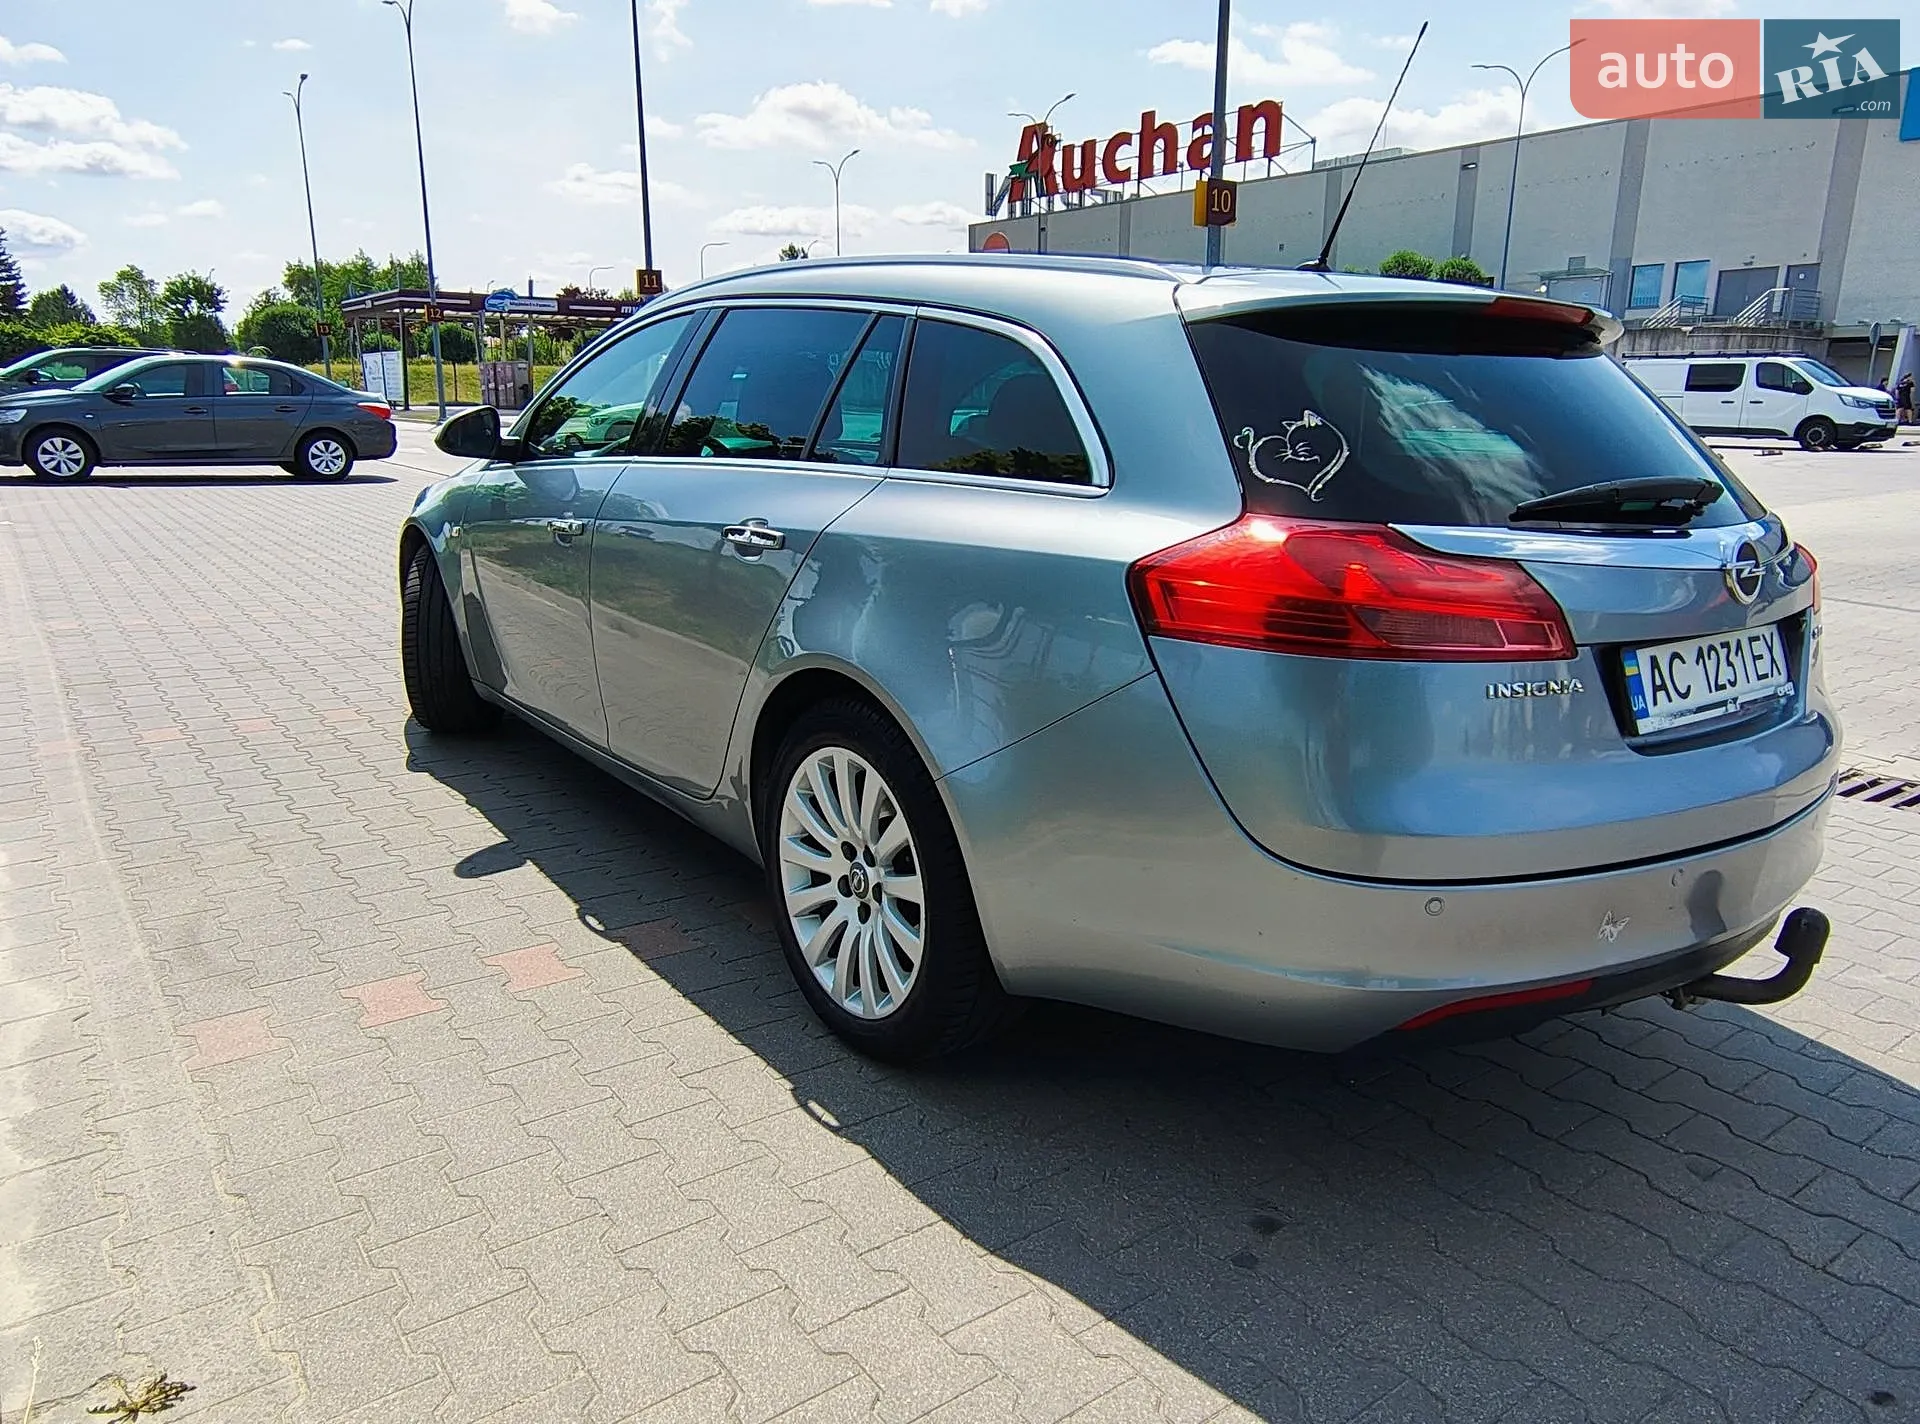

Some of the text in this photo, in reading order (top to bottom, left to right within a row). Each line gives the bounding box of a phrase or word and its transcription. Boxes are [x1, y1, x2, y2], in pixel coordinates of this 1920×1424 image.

[1008, 100, 1283, 203] Auchan
[1211, 188, 1231, 213] 10
[643, 274, 658, 288] 11
[429, 308, 442, 318] 12
[1650, 631, 1782, 707] AC 1231 EX
[1486, 678, 1585, 699] INSIGNIA
[1631, 695, 1646, 712] UA
